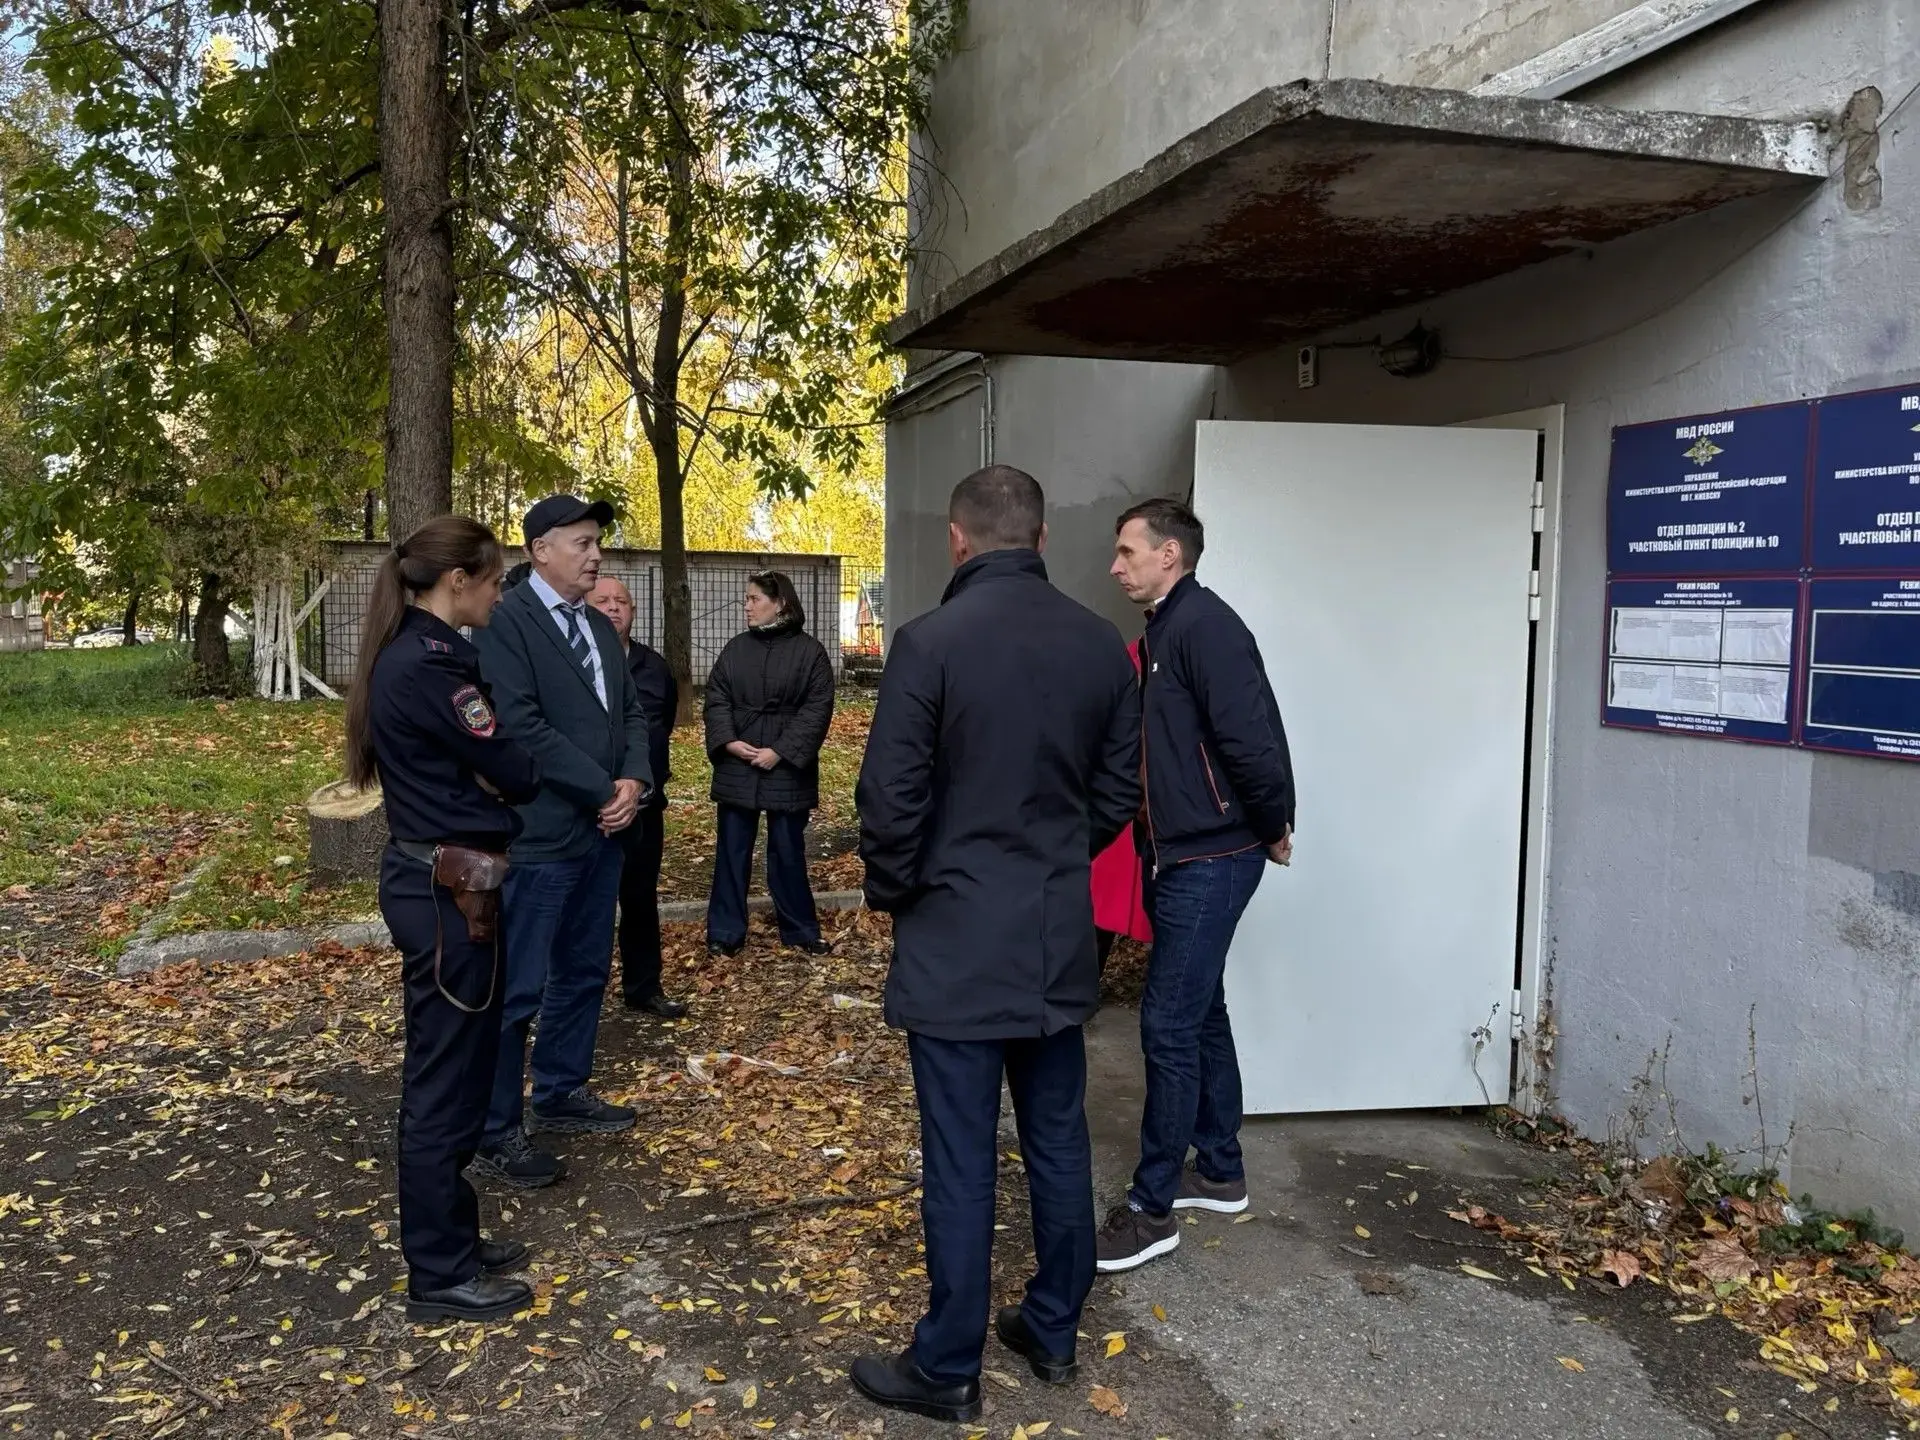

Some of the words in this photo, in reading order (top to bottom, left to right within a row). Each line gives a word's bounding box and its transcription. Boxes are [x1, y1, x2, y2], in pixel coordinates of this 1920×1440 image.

[1901, 396, 1920, 411] МВ
[1676, 426, 1696, 440] МВД
[1697, 420, 1734, 437] РОССИИ
[1684, 471, 1719, 482] УПРАВЛЕНИЕ
[1834, 466, 1887, 479] МИНИСТЕРСТВА
[1625, 486, 1664, 497] МИНИСТЕРСТВА
[1698, 483, 1710, 491] ДЕЛ
[1710, 478, 1749, 490] РОССИЙСКОЙ
[1749, 475, 1787, 486] ФЕДЕРАЦИИ
[1681, 493, 1688, 501] ПО
[1694, 491, 1721, 501] ИЖЕВСКУ
[1877, 512, 1913, 527] ОТДЕЛ
[1657, 524, 1684, 538] ОТДЕЛ
[1685, 522, 1726, 535] ПОЛИЦИИ
[1727, 521, 1738, 533] №
[1738, 520, 1745, 533] 2
[1839, 527, 1911, 545] УЧАСТКОВЫЙ
[1628, 538, 1682, 553] УЧАСТКОВЫЙ
[1683, 538, 1710, 550] ПУНКТ
[1711, 536, 1755, 550] ПОЛИЦИИ
[1755, 536, 1767, 548] №
[1767, 535, 1779, 547] 10
[1676, 582, 1696, 590] РЕЖИМ
[1696, 582, 1720, 590] РАБОТЫ
